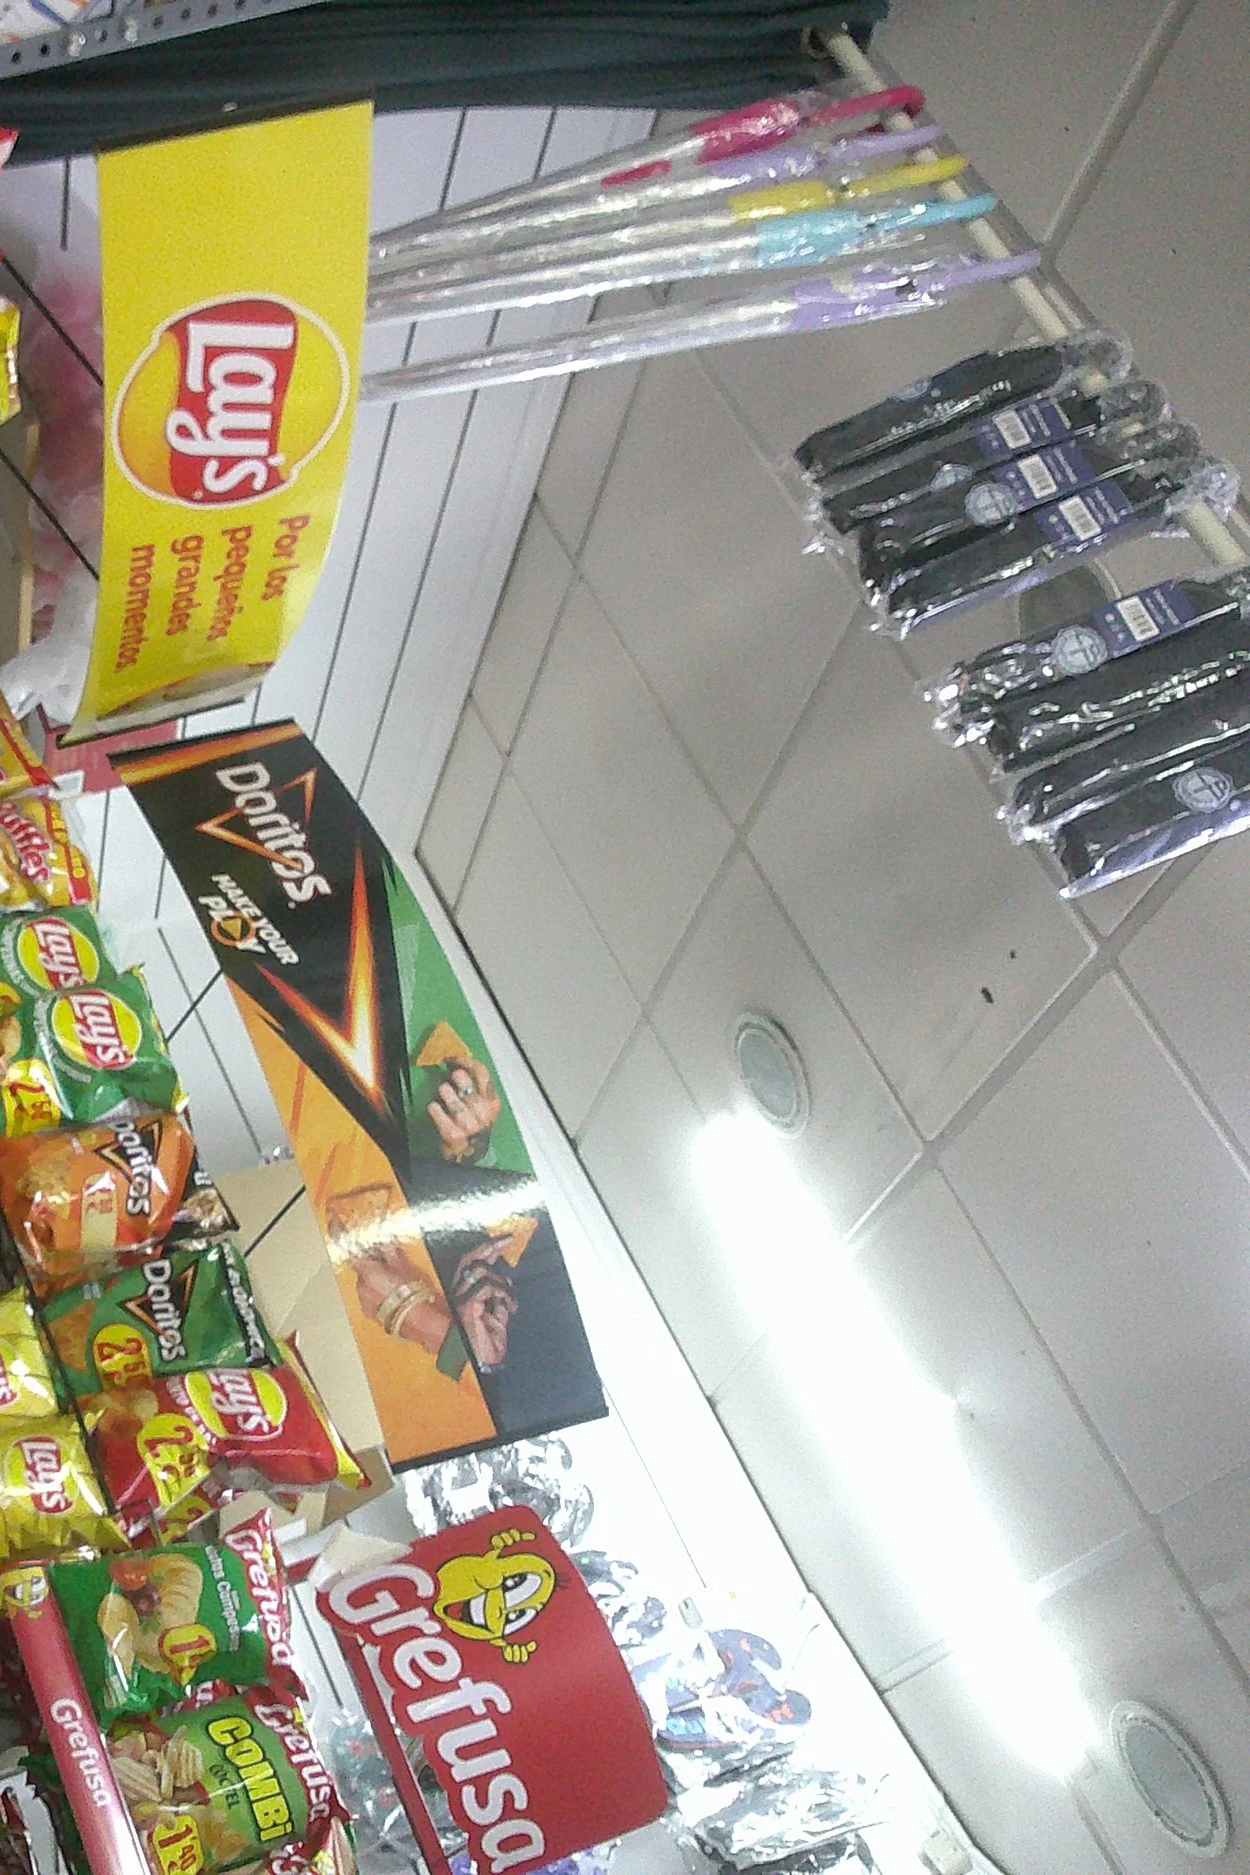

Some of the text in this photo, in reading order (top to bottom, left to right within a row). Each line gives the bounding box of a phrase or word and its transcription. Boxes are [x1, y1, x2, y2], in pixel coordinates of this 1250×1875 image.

[165, 321, 296, 497] Lay's
[165, 535, 205, 637] grandes
[205, 524, 254, 642] pequeños
[260, 513, 312, 602] Por los
[215, 762, 332, 903] Doritos
[210, 873, 300, 965] MAKE YOUR
[143, 1259, 187, 1361] Doritos
[224, 1529, 292, 1666] Grefusa
[49, 1699, 109, 1808] Grefusa
[253, 1704, 332, 1823] Grefusa
[328, 1563, 546, 1874] Grefusa
